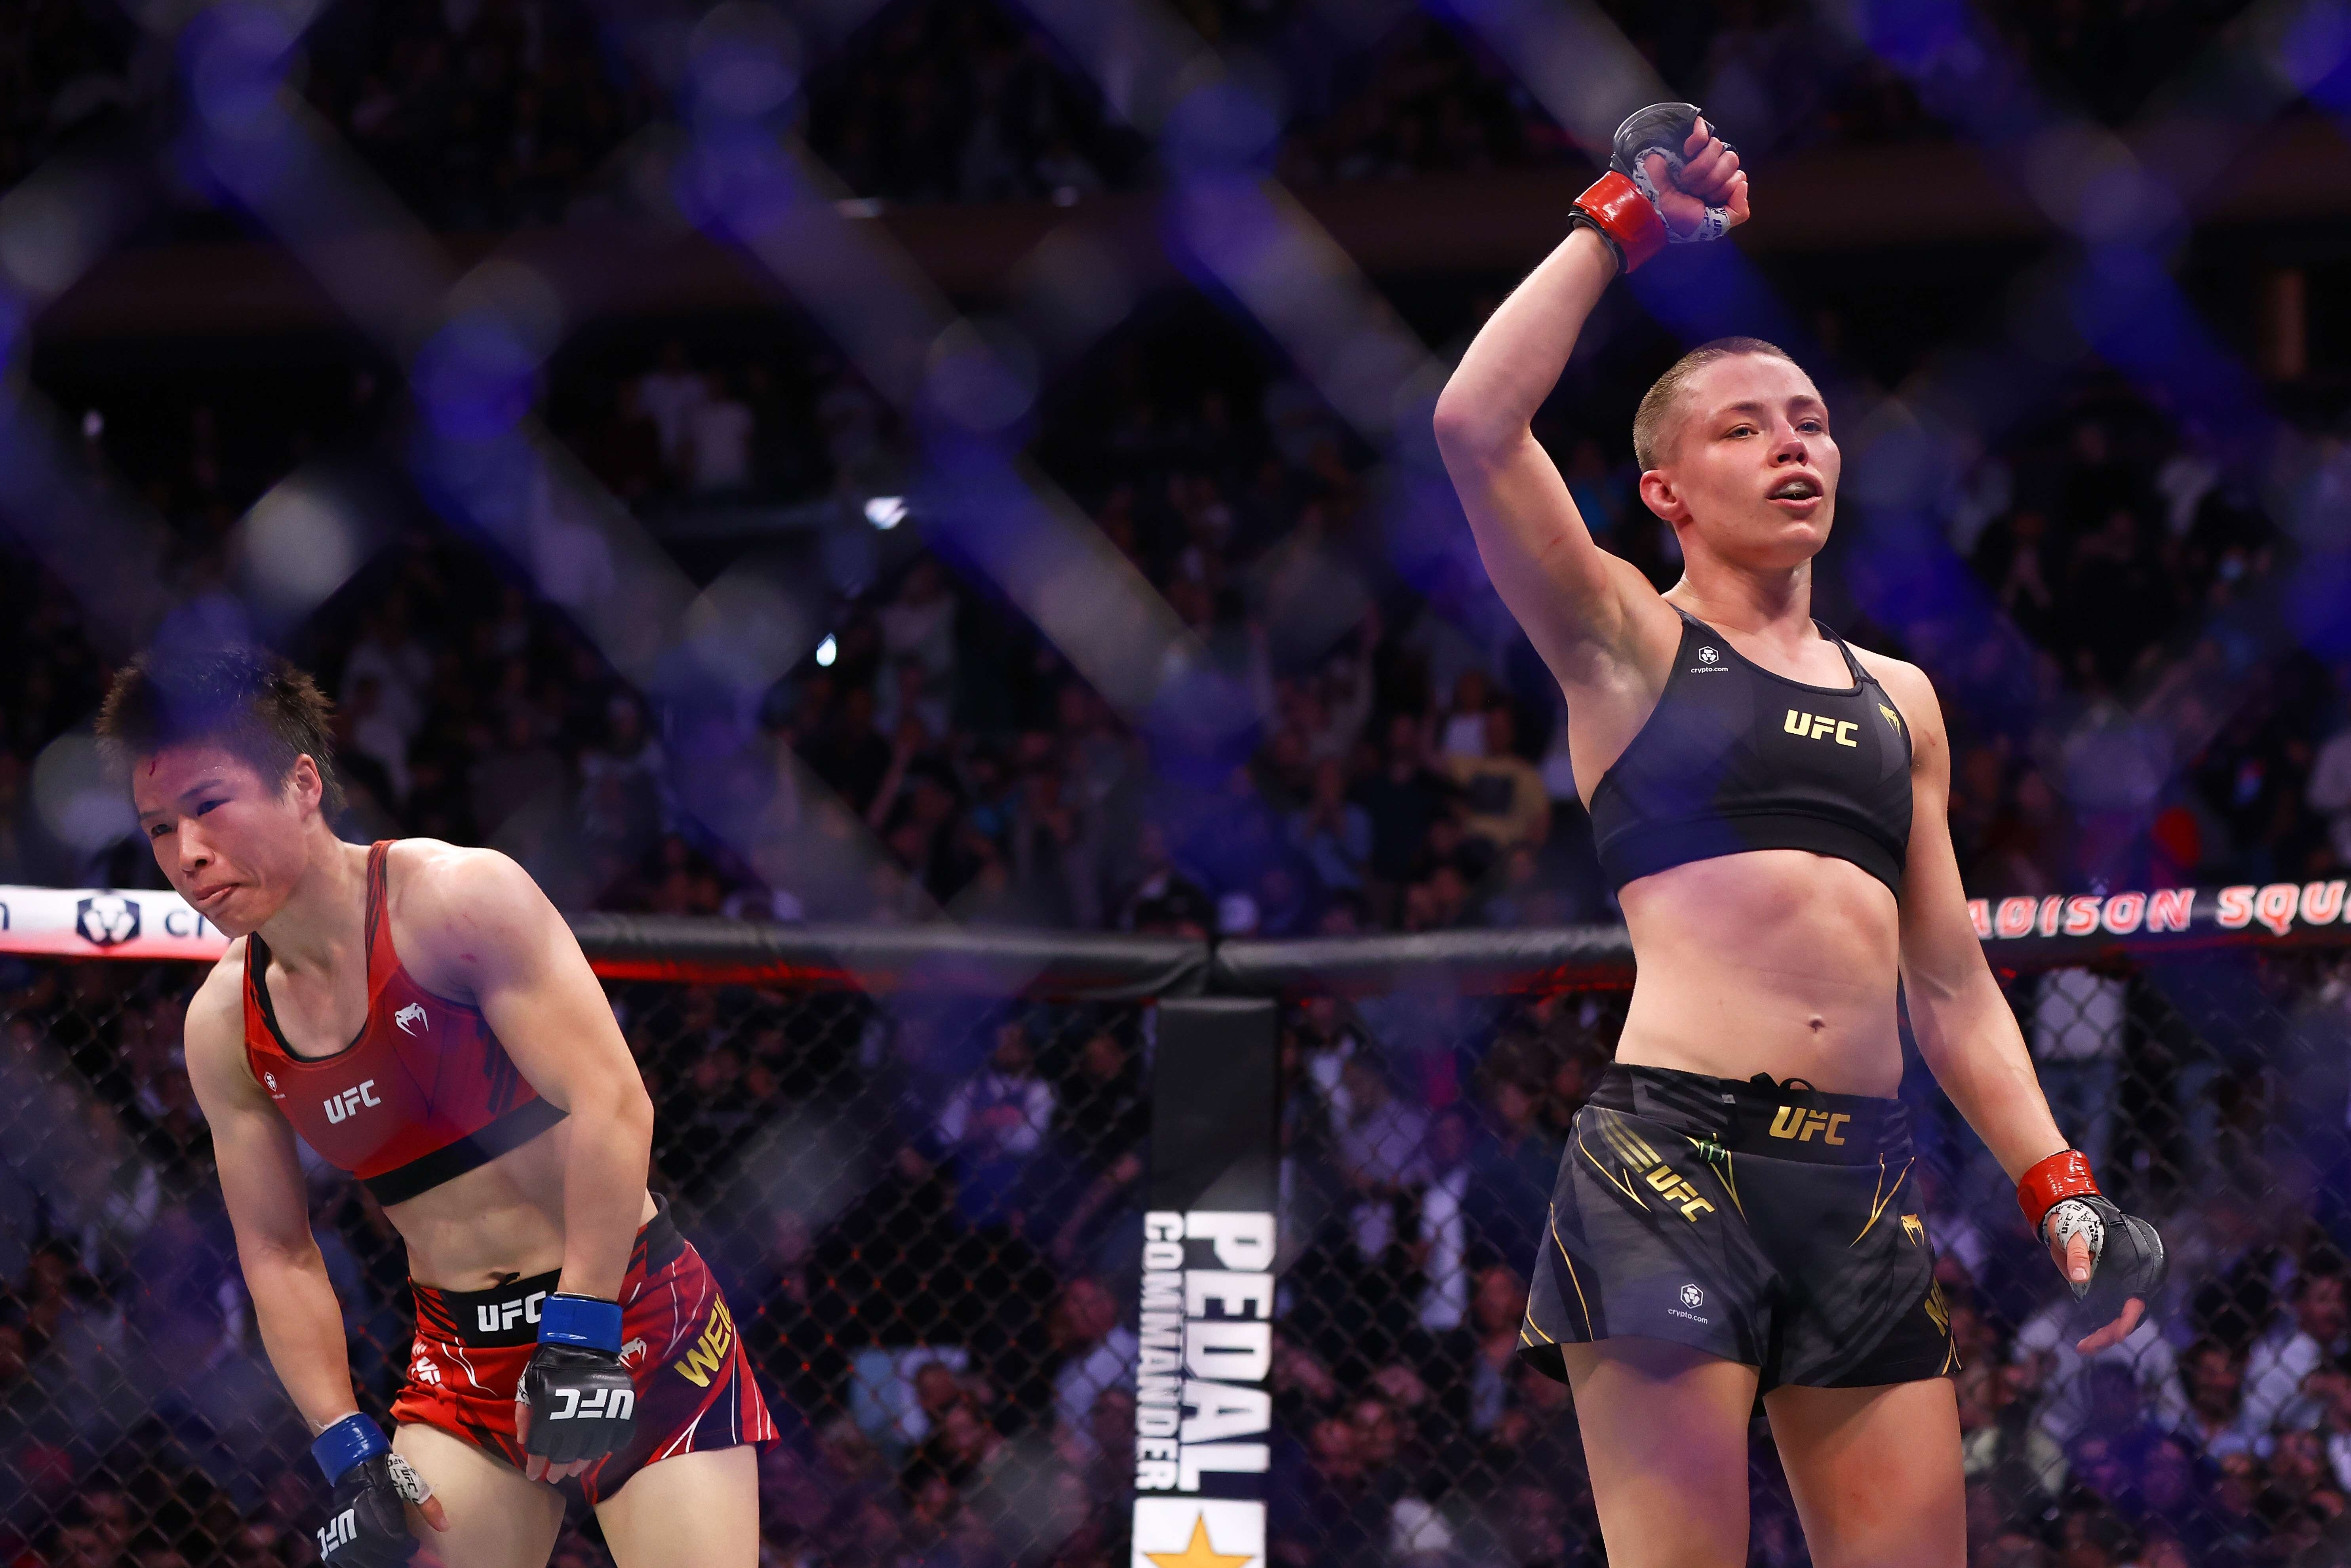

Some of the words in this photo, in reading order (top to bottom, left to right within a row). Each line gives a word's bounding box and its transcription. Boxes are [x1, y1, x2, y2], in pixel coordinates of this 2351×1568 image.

[1784, 709, 1858, 747] UFC
[2215, 879, 2351, 937] SQU
[323, 1079, 381, 1124] UFC
[1769, 1106, 1851, 1146] UFC
[1646, 1165, 1715, 1223] UFC
[2061, 1213, 2073, 1234] UFC
[477, 1290, 546, 1332] UFC
[1668, 1309, 1708, 1324] crypto.com
[1135, 1211, 1185, 1491] COMMANDER
[1178, 1210, 1277, 1492] PEDAL
[416, 1356, 448, 1390] UF
[549, 1389, 634, 1420] UFC
[401, 1469, 419, 1493] UFC
